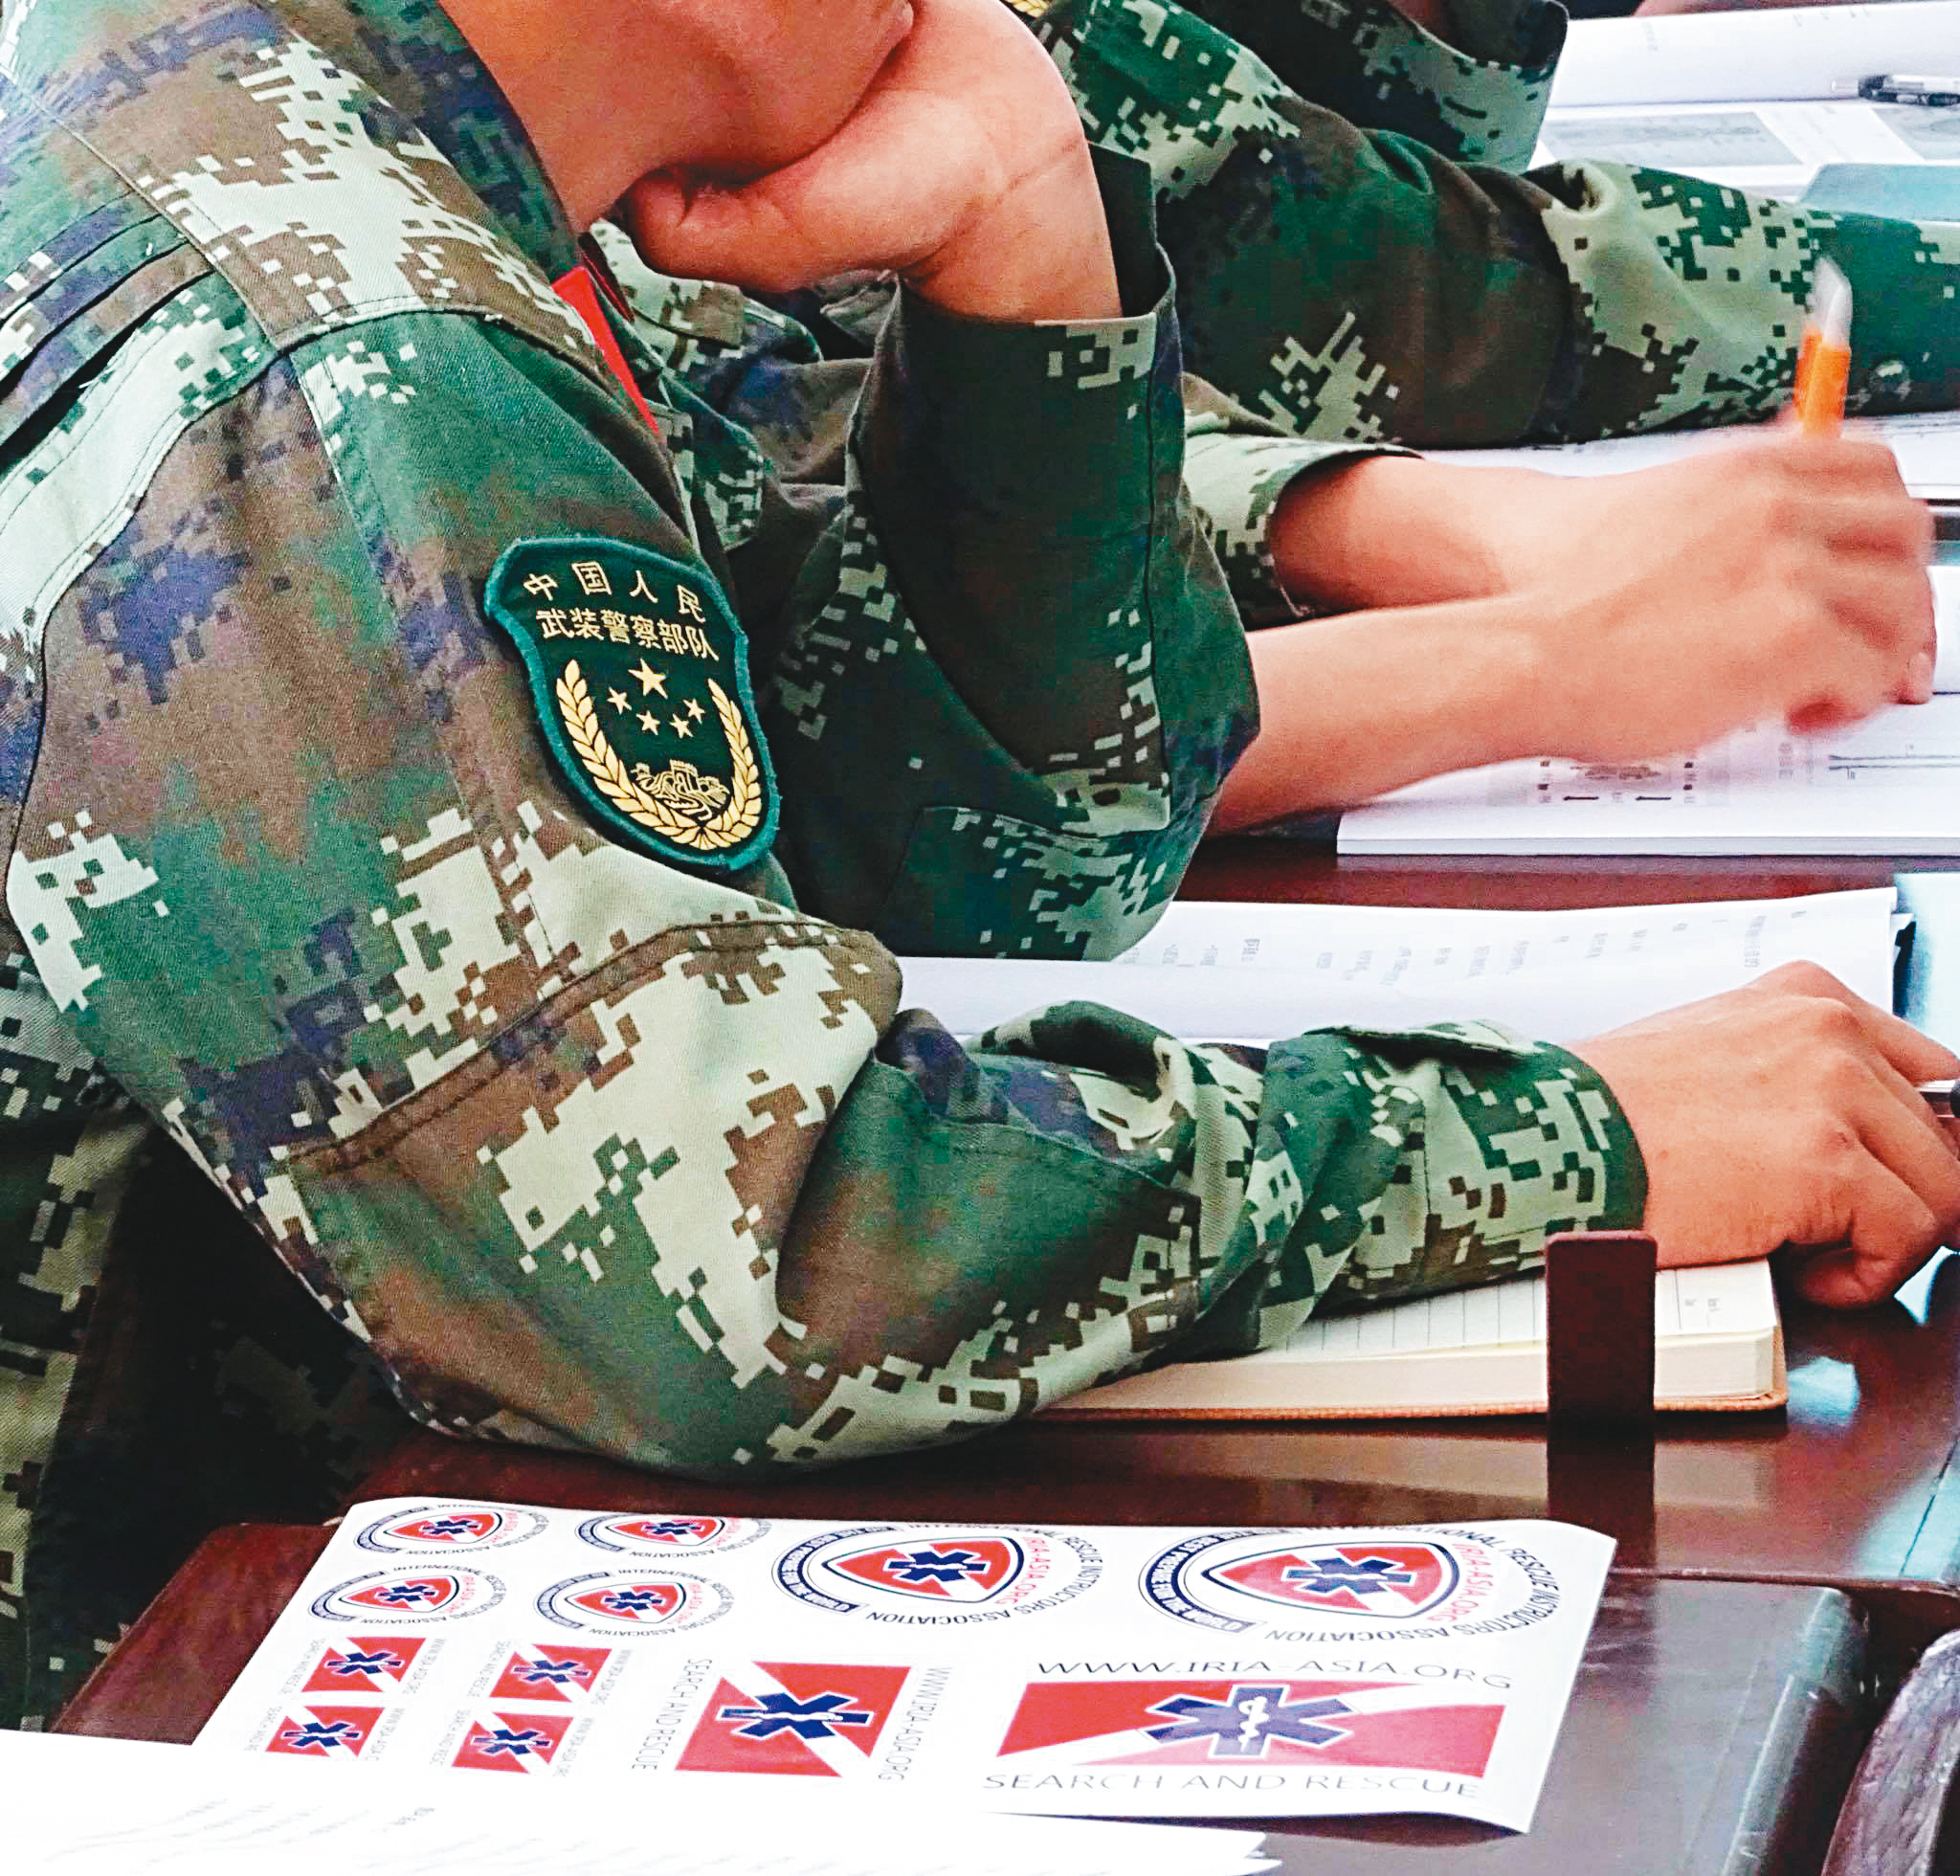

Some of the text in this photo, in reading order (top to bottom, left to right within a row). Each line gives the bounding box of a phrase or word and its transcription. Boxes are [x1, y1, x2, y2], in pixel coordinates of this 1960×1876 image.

[523, 561, 706, 622] 中国人民
[536, 608, 719, 660] 武装警察部队
[1499, 1548, 1559, 1591] RESCUE
[865, 1610, 1011, 1625] ASSOCIATION
[1452, 1589, 1561, 1635] INSTRUCTORS
[1263, 1627, 1450, 1642] ASSOCIATION
[673, 1658, 713, 1699] SEARCH
[1037, 1660, 1512, 1689] WWW.IRIA-ASIA.ORG
[983, 1773, 1480, 1798] SEARCH AND RESCUE
